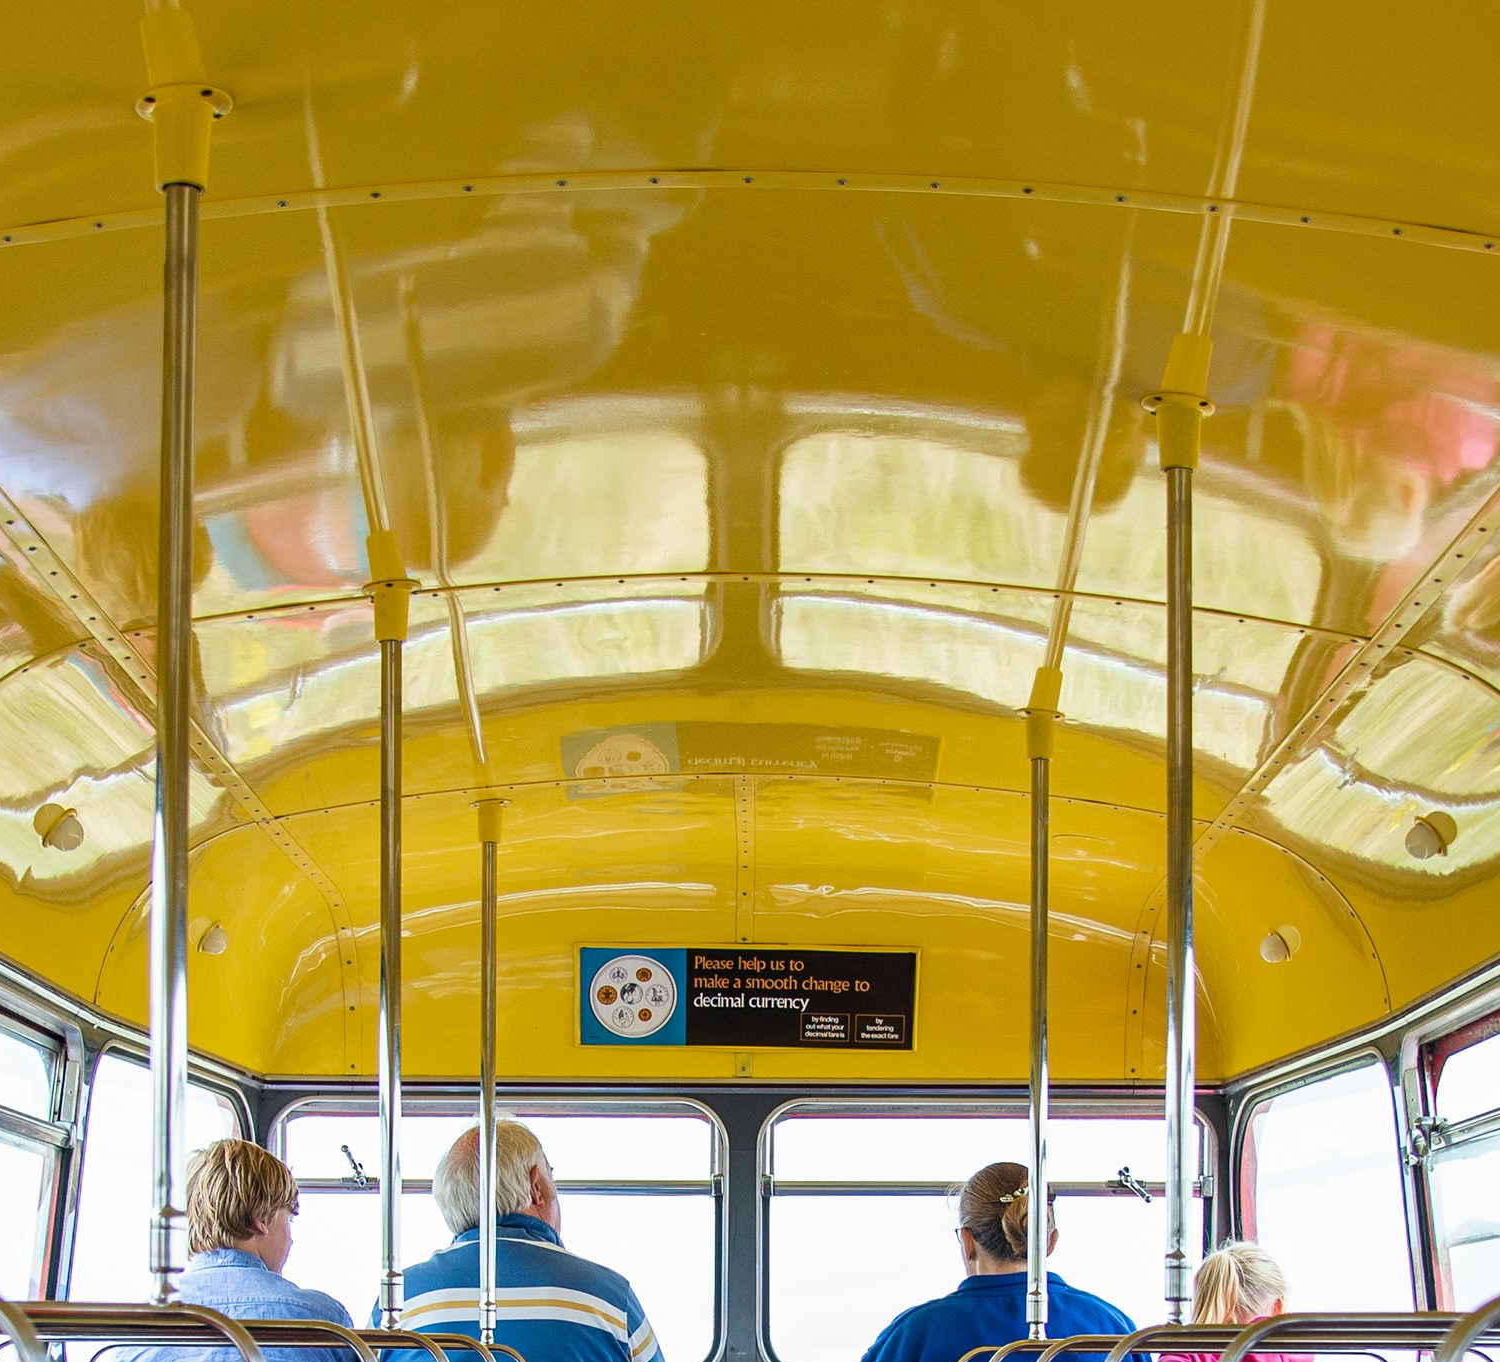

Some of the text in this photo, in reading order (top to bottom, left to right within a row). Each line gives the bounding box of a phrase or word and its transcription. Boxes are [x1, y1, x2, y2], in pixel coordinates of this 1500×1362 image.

[694, 955, 805, 973] Please help us to
[694, 974, 871, 993] make a smooth change to
[693, 993, 809, 1012] decimal currency
[819, 1016, 839, 1024] finding
[831, 1024, 844, 1032] your
[866, 1025, 894, 1033] tendering
[804, 1031, 828, 1039] decimal
[828, 1031, 839, 1039] fare
[860, 1032, 899, 1040] the exact fare
